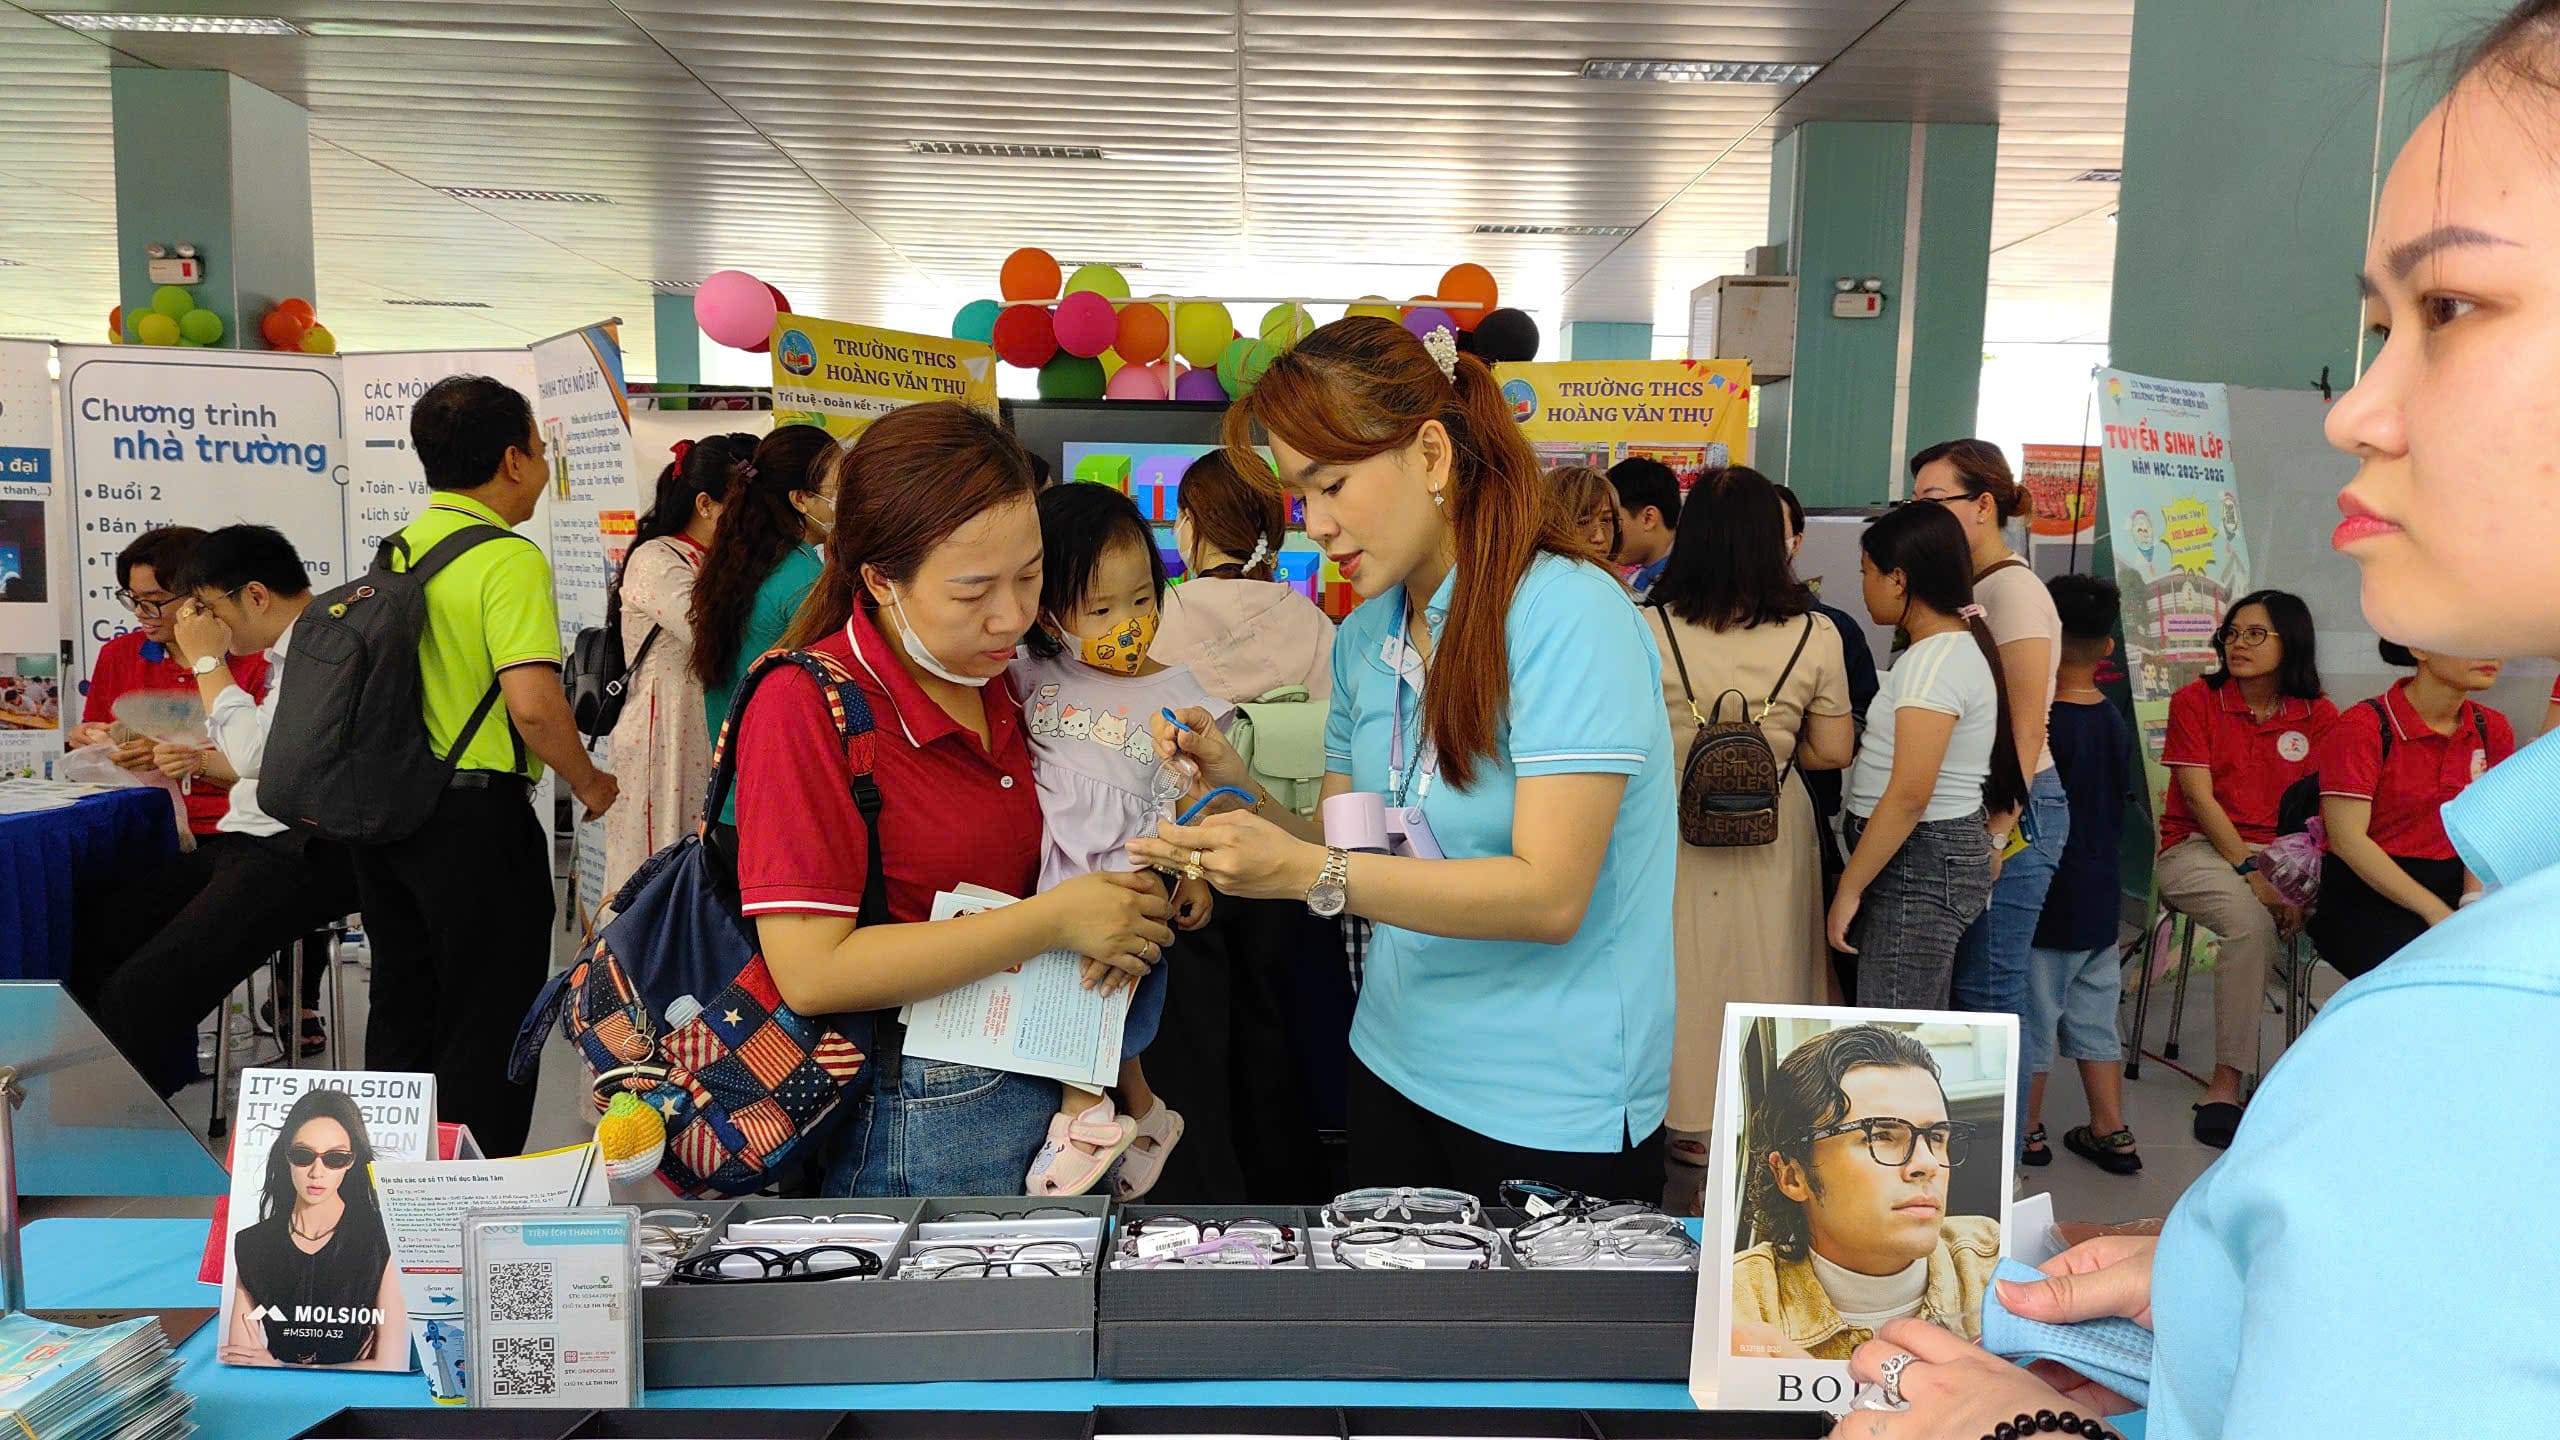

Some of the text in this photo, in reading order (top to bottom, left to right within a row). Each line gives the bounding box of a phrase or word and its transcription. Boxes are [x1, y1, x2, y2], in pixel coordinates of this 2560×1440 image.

[834, 338, 956, 369] TRƯỜNG THCS
[364, 378, 434, 399] CÁC MÔN
[827, 362, 966, 400] HOÀNG VĂN THỤ
[1559, 377, 1703, 397] TRƯỜNG THCS
[778, 392, 793, 402] Trí
[796, 393, 816, 406] tuệ
[824, 397, 852, 409] Đoàn
[854, 398, 872, 411] kết
[81, 397, 276, 429] Chương trình
[1547, 401, 1714, 427] HOÀNG VĂN THỤ
[2105, 417, 2159, 452] TUYỂN
[2164, 431, 2196, 456] SINH
[2200, 431, 2223, 459] LỚP
[113, 430, 327, 473] nhà trường
[1155, 472, 1163, 483] 2
[2132, 457, 2151, 475] NĂM
[2177, 464, 2225, 482] 2025-2026
[98, 482, 161, 500] Buổi 2
[366, 480, 394, 494] Toán
[394, 508, 410, 521] sử
[100, 518, 136, 533] Bán
[1280, 568, 1288, 578] 9
[249, 1076, 422, 1099] IT'S MOLSION
[363, 1105, 419, 1125] SION
[529, 1228, 548, 1238] TIỆN
[551, 1226, 566, 1237] ÍCH
[568, 1228, 599, 1236] THANH
[295, 1305, 385, 1325] MOLSION
[282, 1328, 344, 1339] #MS3110 A32
[1777, 1374, 1860, 1403] BO
